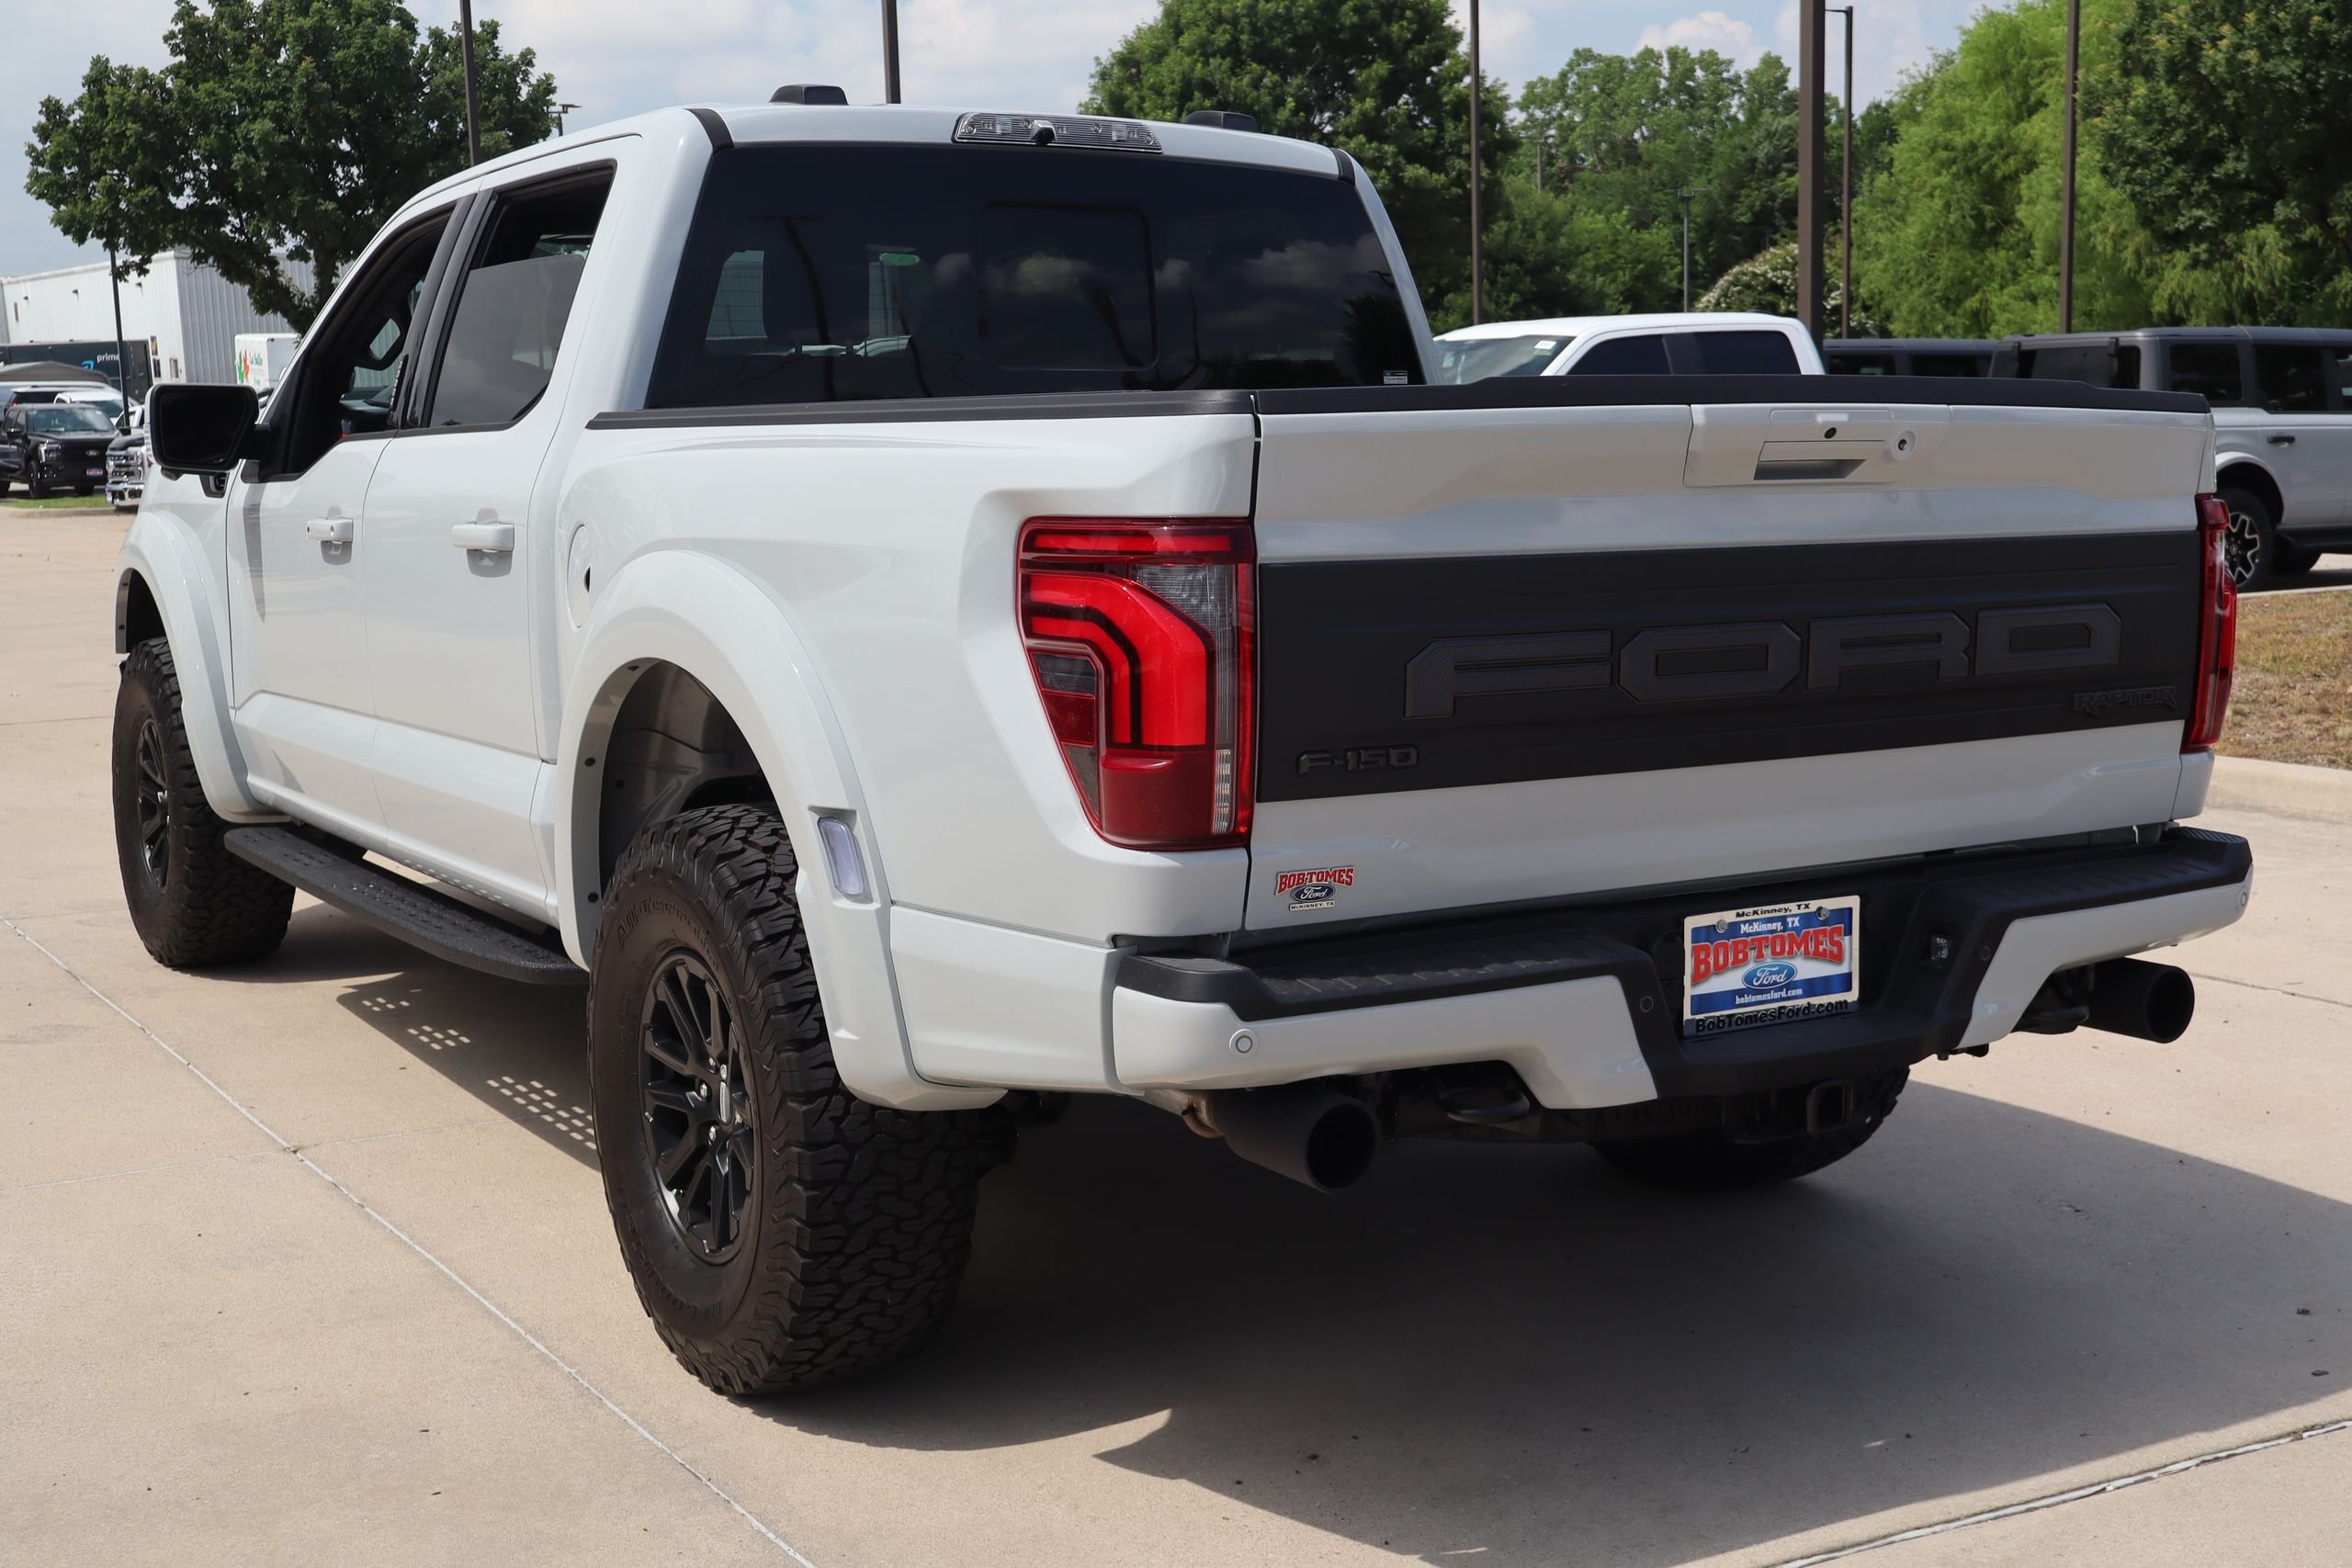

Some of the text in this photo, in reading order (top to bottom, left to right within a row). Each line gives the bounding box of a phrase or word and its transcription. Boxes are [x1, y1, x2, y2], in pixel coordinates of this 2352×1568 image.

[1403, 601, 2121, 719] FORD
[2072, 684, 2177, 716] RAPTOR
[1295, 743, 1419, 777] F-150
[1300, 886, 1329, 899] Ford
[1736, 902, 1811, 919] McKinney, TX
[1740, 917, 1800, 934] McKinney, TX
[1752, 966, 1787, 986] Ford
[1735, 987, 1804, 1005] bobtomesford.com
[1696, 998, 1849, 1032] BobTomesFord.com
